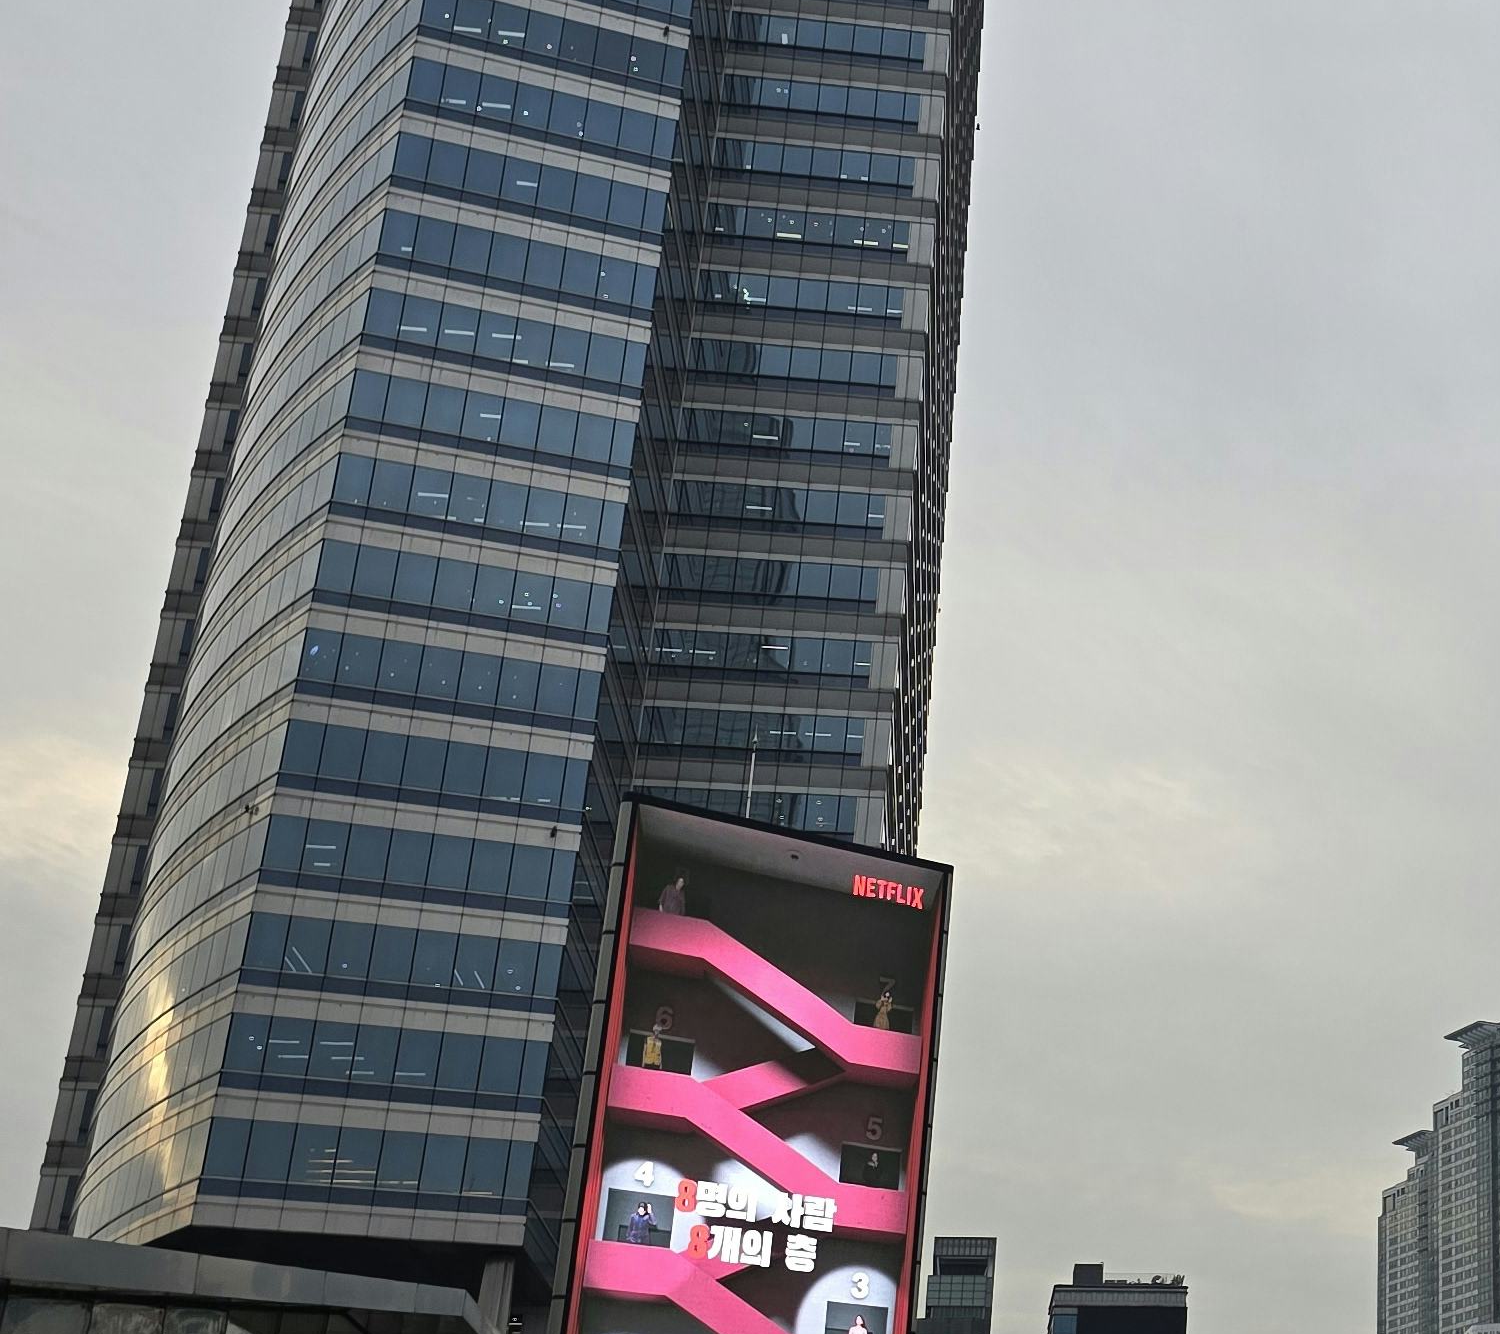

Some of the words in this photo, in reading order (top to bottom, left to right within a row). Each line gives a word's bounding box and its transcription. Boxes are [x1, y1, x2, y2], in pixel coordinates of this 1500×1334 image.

[852, 873, 925, 910] NETFLIX
[655, 1006, 674, 1030] 6
[865, 1116, 883, 1140] 5
[634, 1161, 655, 1187] 4
[675, 1178, 758, 1223] 8명의
[771, 1191, 838, 1233] 사람
[687, 1224, 773, 1268] 8개의
[784, 1233, 818, 1273] 층
[850, 1271, 870, 1299] 3
